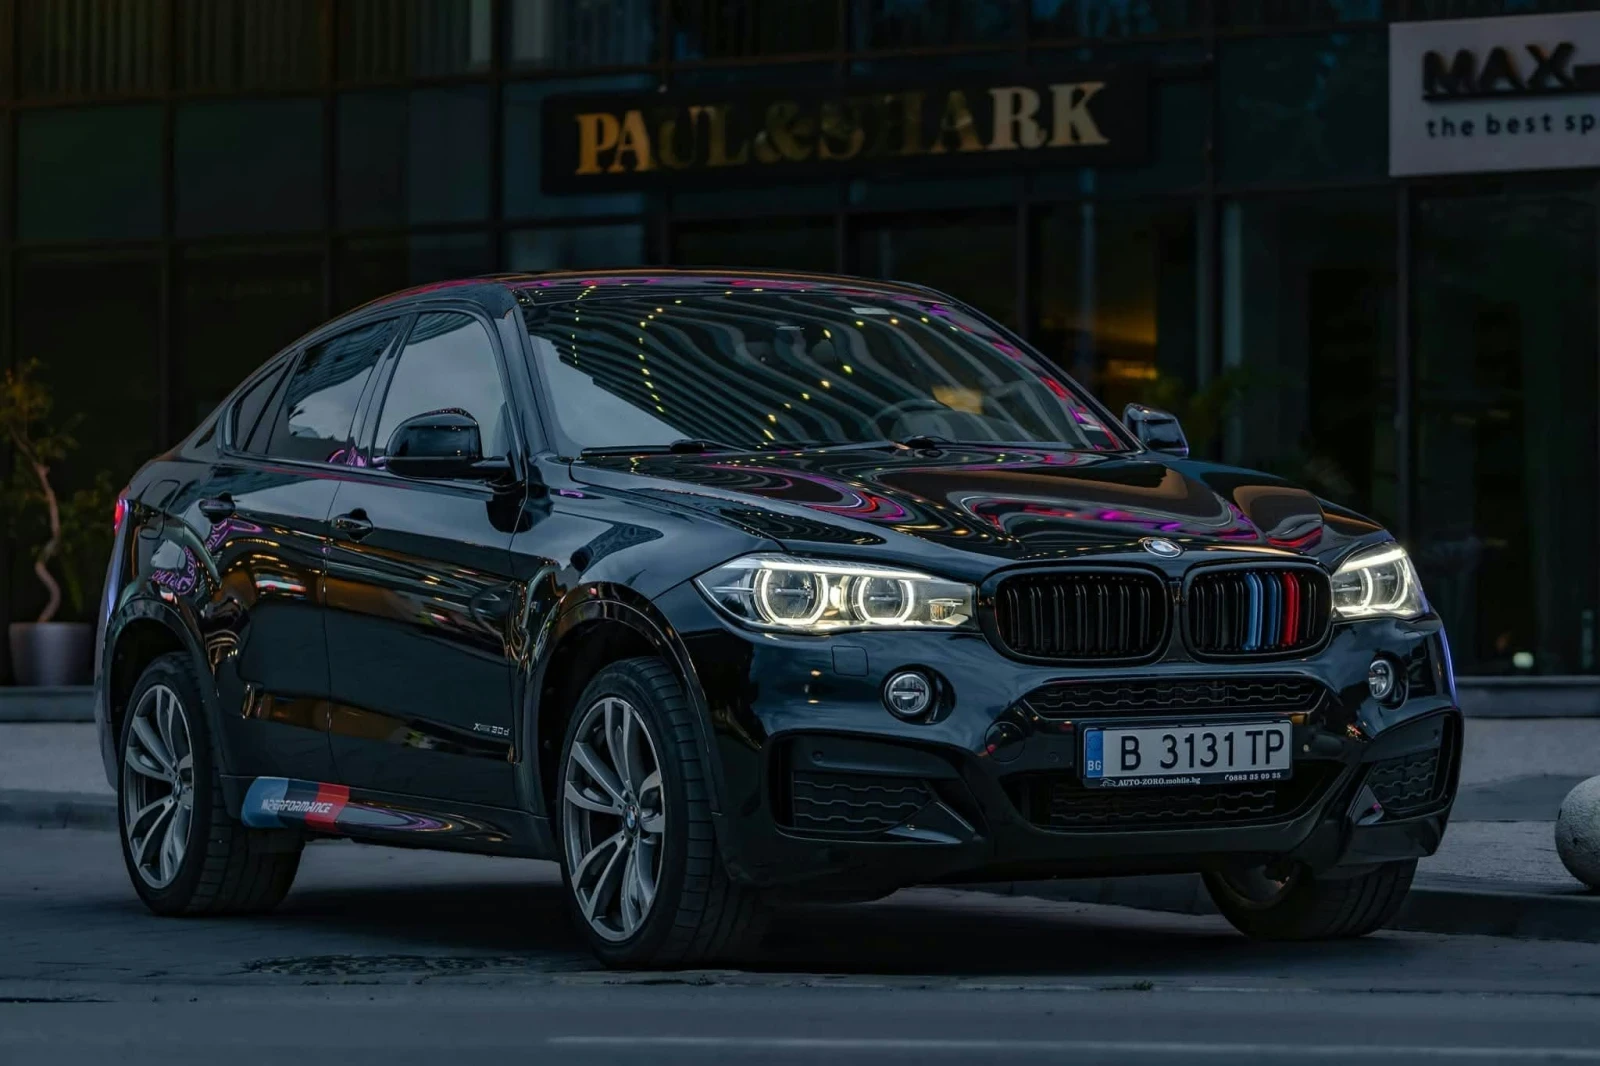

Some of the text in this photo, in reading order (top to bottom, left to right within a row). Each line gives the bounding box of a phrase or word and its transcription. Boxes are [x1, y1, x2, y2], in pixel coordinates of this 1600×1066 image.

[1426, 116, 1475, 138] the
[1486, 112, 1552, 135] best
[1121, 729, 1284, 771] B 3131 TP
[1087, 760, 1101, 771] BG
